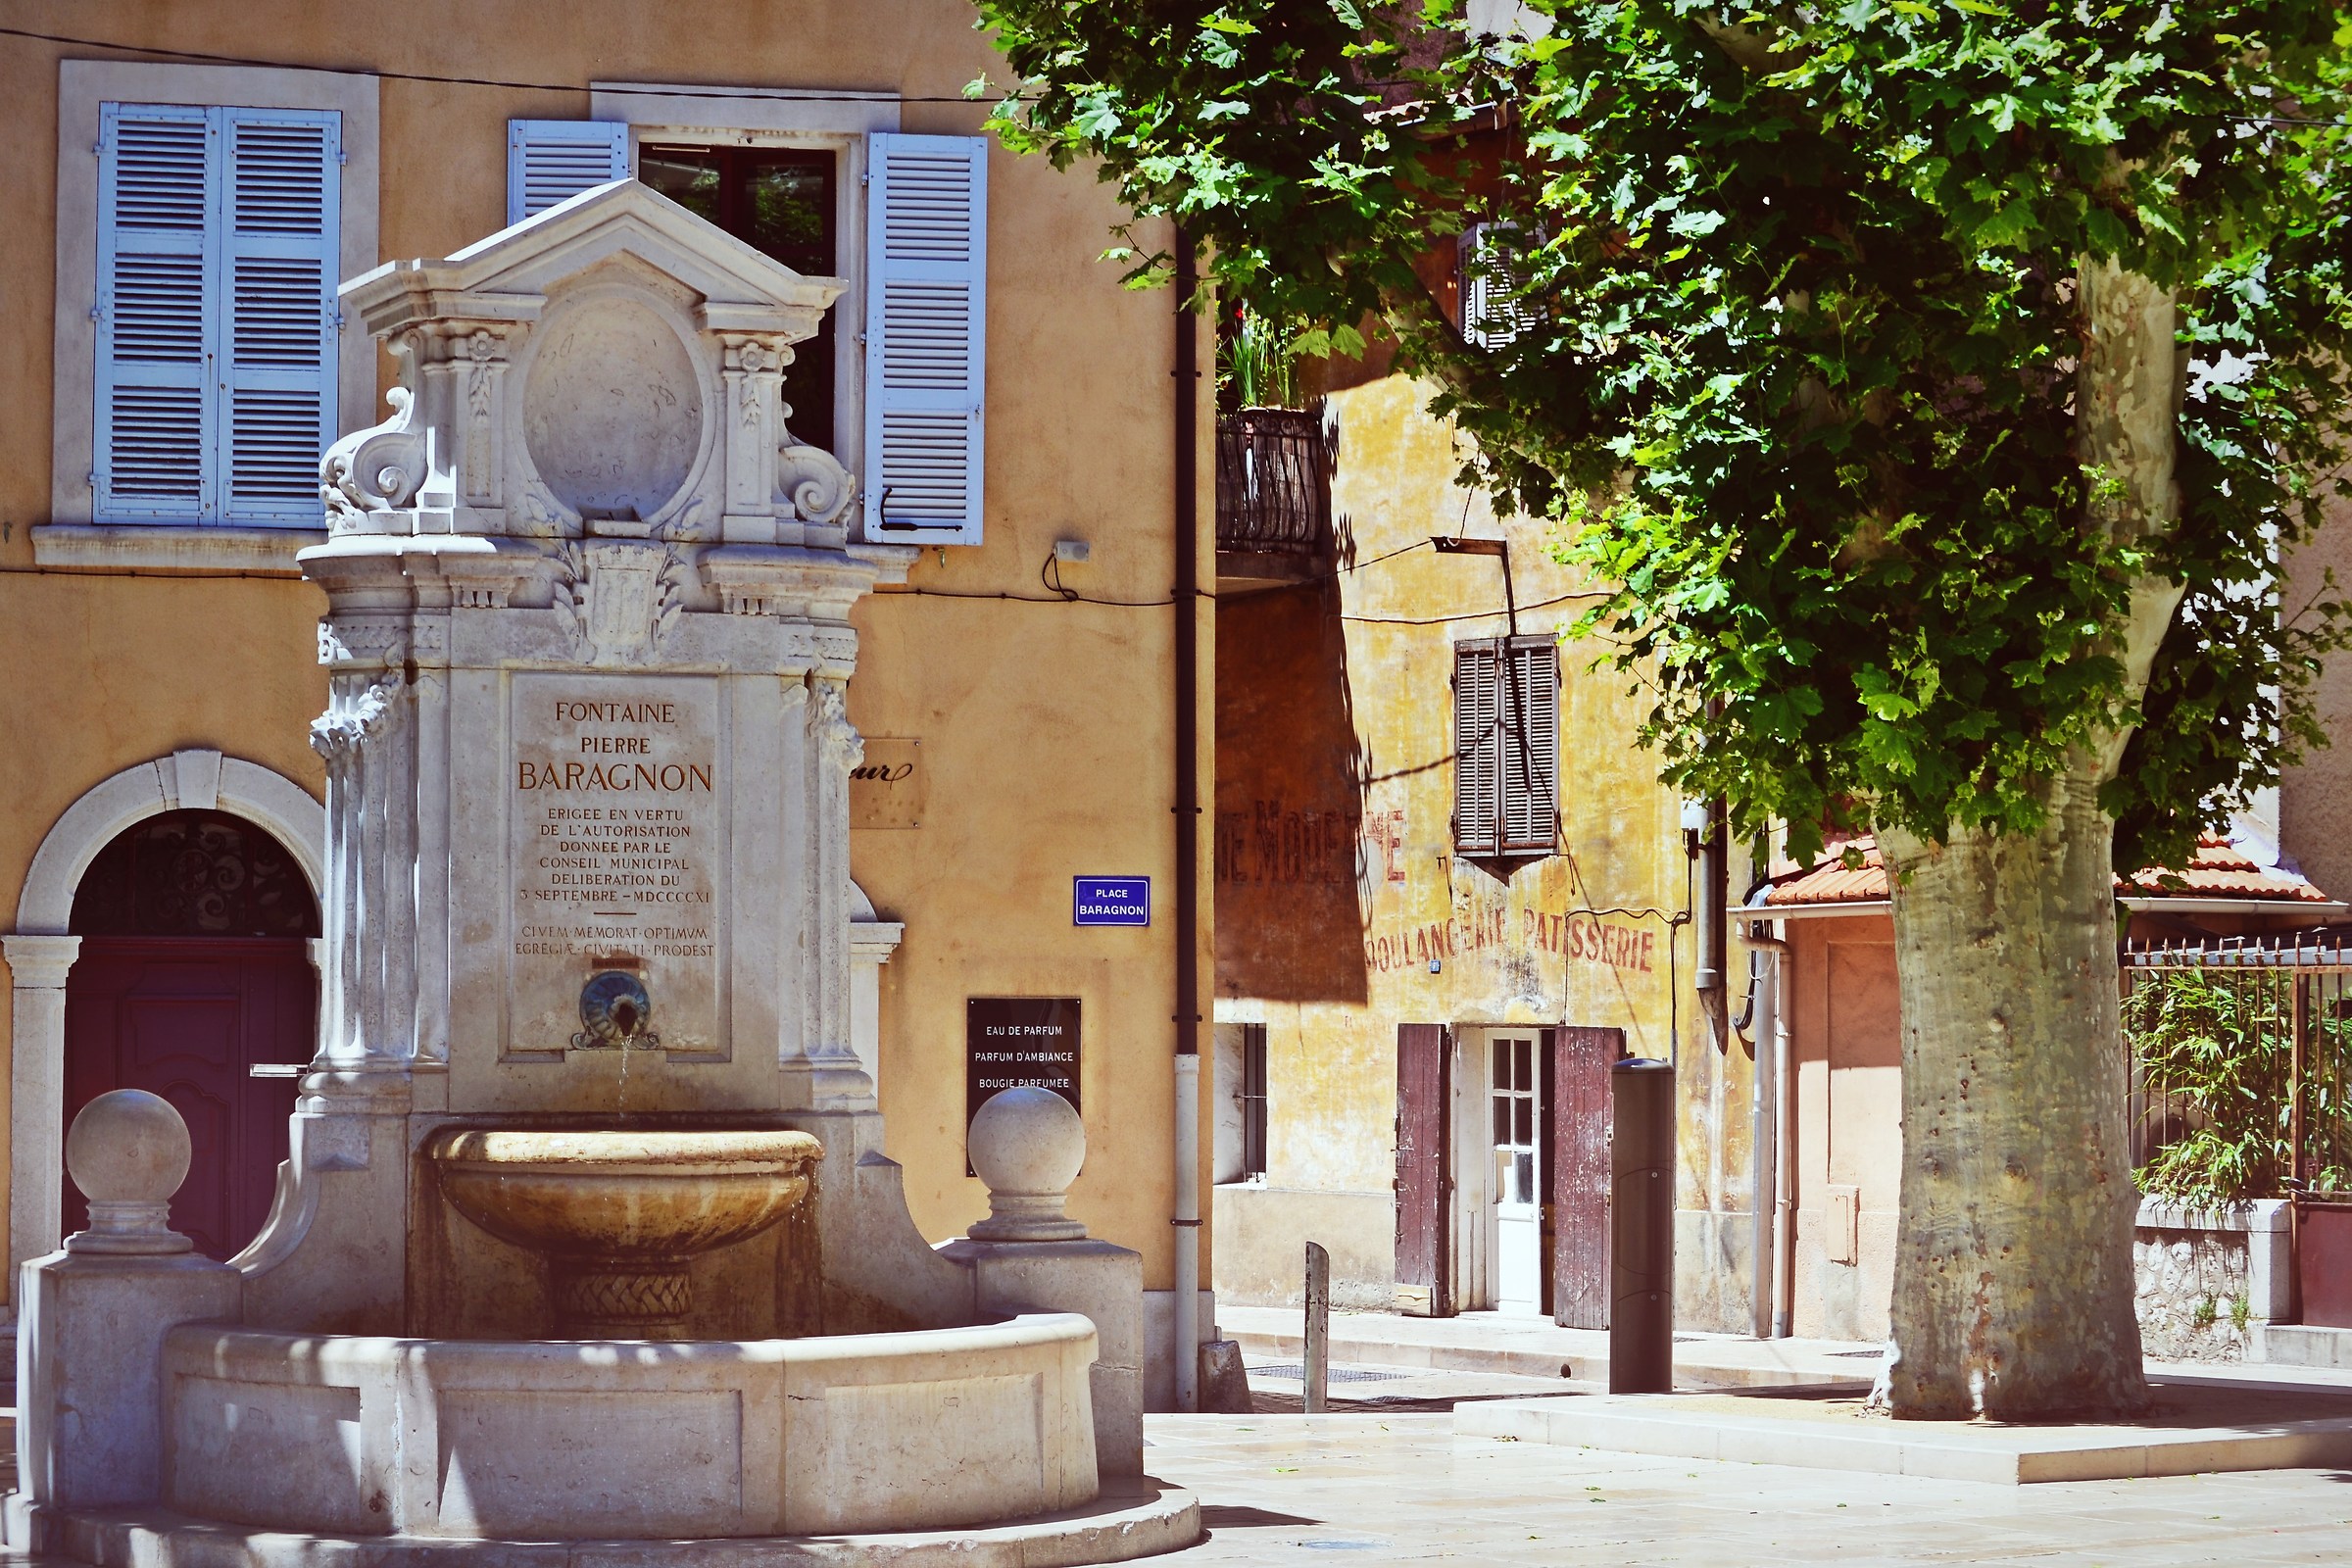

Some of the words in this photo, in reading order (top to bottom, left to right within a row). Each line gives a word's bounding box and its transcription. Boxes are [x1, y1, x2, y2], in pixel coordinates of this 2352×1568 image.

[556, 702, 675, 723] FONTAINE
[581, 737, 651, 755] PIERRE
[518, 761, 711, 792] BARAGNON
[548, 808, 602, 820] ERIGEE
[610, 808, 627, 820] EN
[635, 809, 684, 821] VERTU
[540, 824, 560, 836] DE
[568, 825, 691, 838] L'AUTORISATION
[560, 841, 618, 853] DONNEE
[623, 842, 650, 854] PAR
[655, 843, 670, 854] LE
[539, 858, 601, 869] CONSEIL
[611, 858, 689, 870] MUNICIPAL
[552, 873, 655, 886] DELIBERATION
[661, 875, 680, 887] DU
[519, 889, 528, 900] 3
[535, 890, 617, 902] SEPTEMBRE
[1096, 889, 1128, 898] PLACE
[1079, 905, 1145, 915] BARAGNON
[1523, 908, 1654, 973] PATISSERIE
[654, 945, 714, 956] PRODEST
[986, 1026, 1004, 1036] EAU
[1008, 1026, 1021, 1036] DE
[1024, 1026, 1062, 1036] PARFUM
[975, 1053, 1013, 1062] PARFUM
[1016, 1051, 1074, 1061] D'AMBIANCE
[979, 1079, 1015, 1088] BOUGIE
[1018, 1079, 1069, 1088] PARFUMEE
